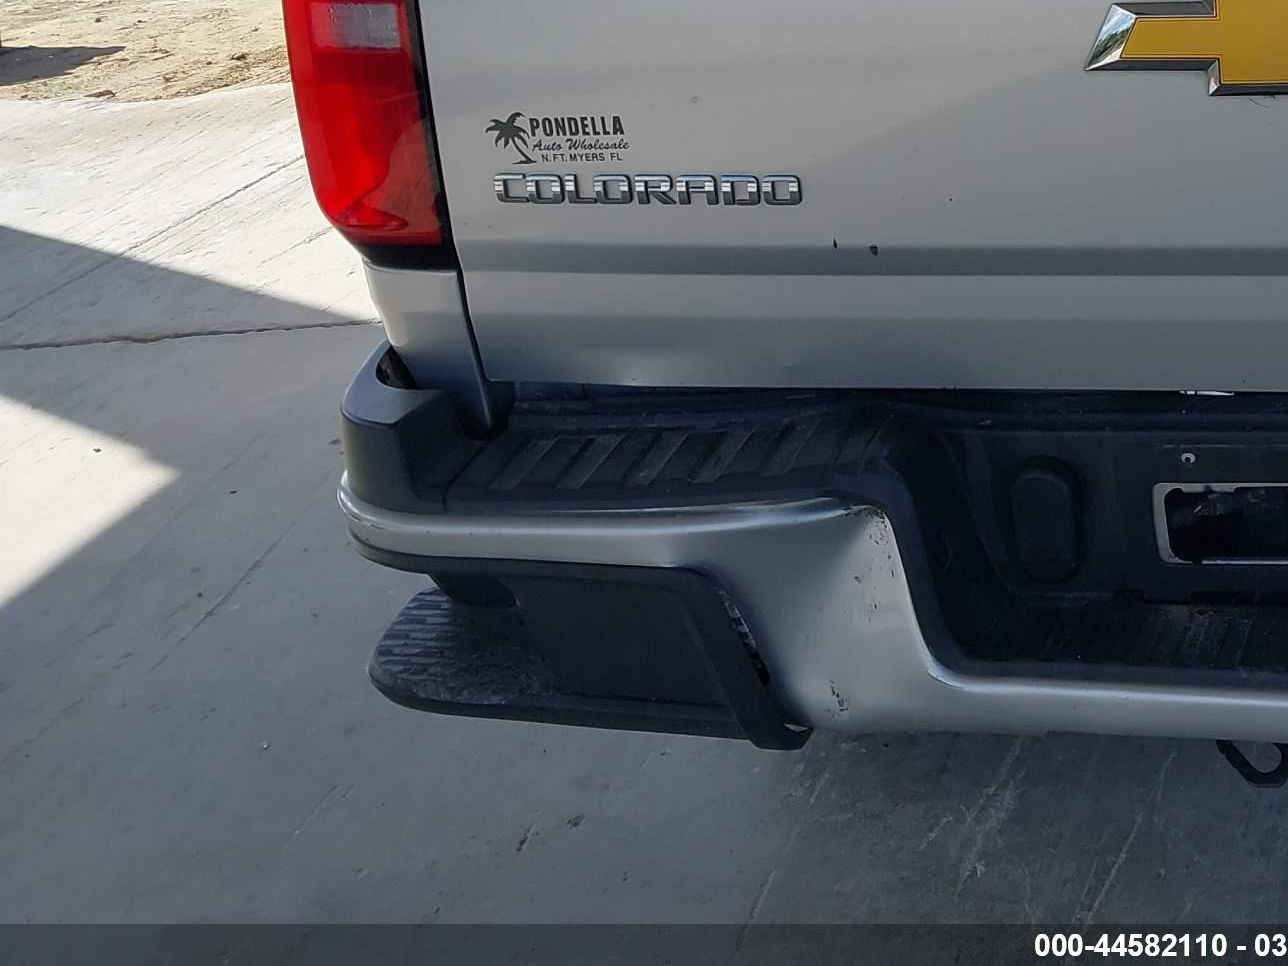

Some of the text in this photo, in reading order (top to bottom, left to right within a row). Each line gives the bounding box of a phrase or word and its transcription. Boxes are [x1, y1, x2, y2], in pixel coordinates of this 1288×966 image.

[528, 115, 625, 137] PONDELLA
[531, 138, 630, 152] Auto Wholesale
[609, 152, 623, 162] FL
[493, 172, 803, 206] COLORADO
